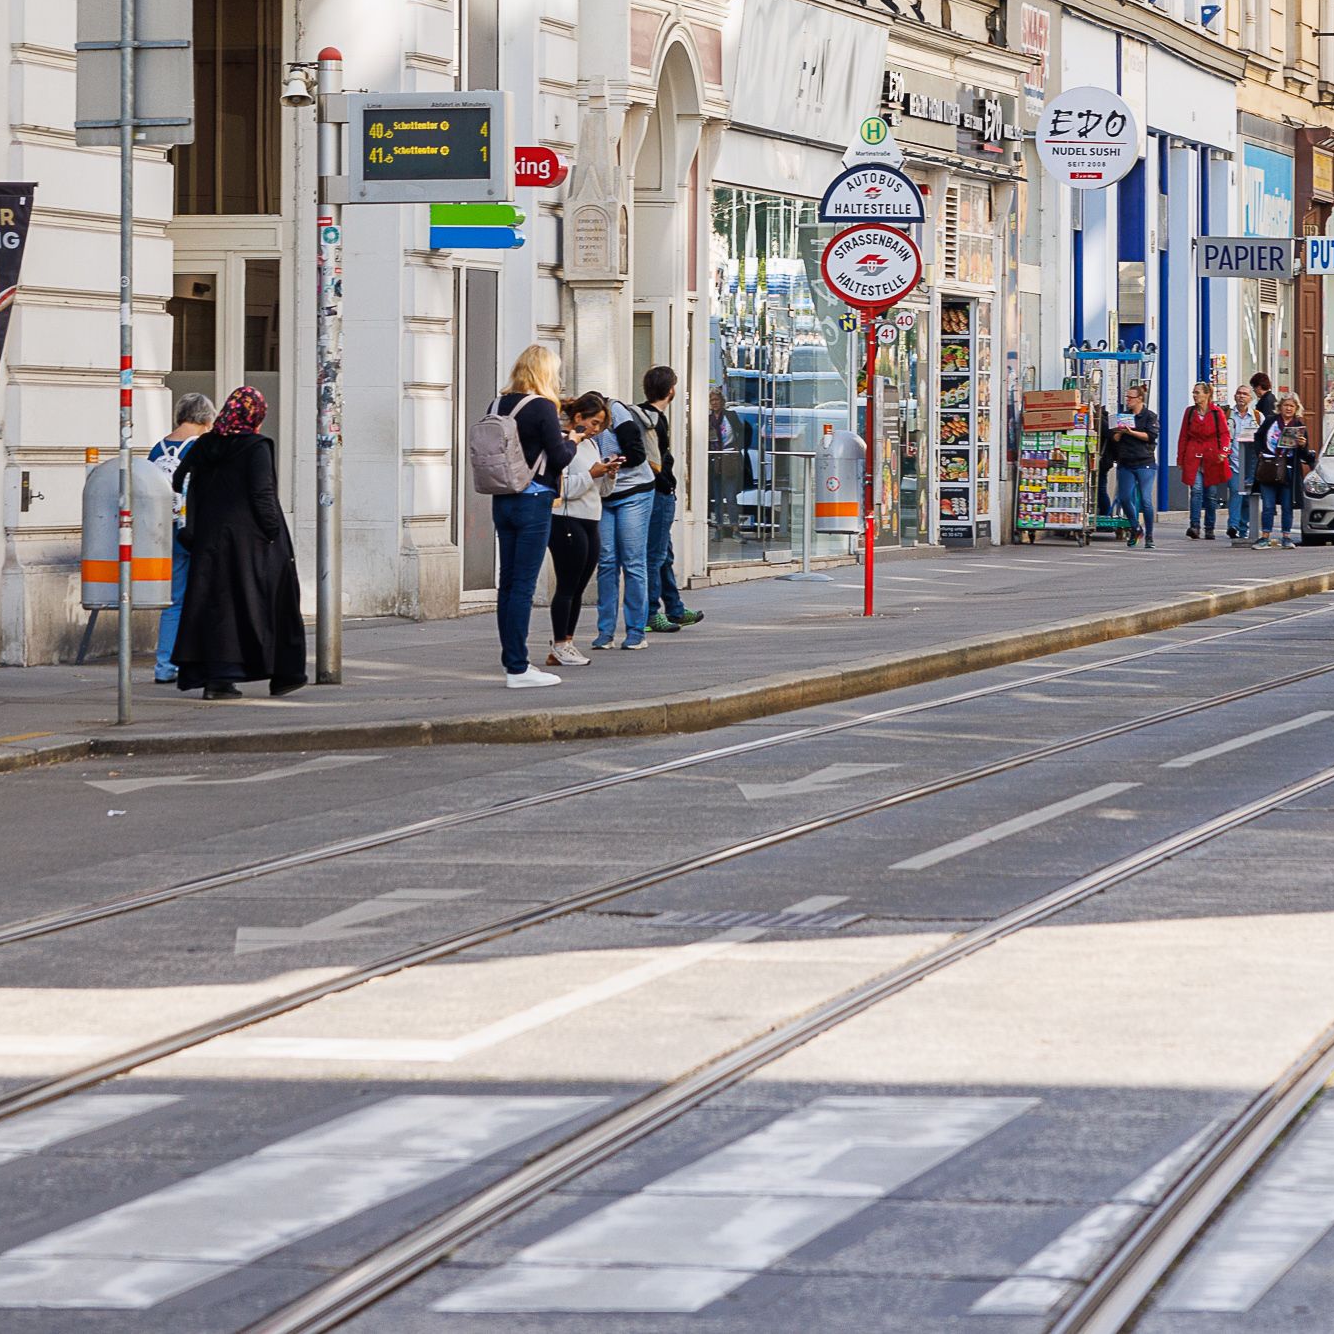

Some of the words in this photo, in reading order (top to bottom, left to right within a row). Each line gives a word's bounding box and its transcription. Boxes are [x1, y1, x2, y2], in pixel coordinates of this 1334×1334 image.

[368, 123, 384, 139] 40
[393, 120, 439, 131] Schottentor
[480, 121, 488, 137] 4
[867, 123, 881, 140] H
[1049, 109, 1127, 139] EDO
[368, 147, 384, 164] 41
[393, 145, 439, 155] Schottentor
[480, 146, 488, 162] 1
[1052, 147, 1087, 156] NUDEL
[1089, 147, 1121, 157] SUSHI
[846, 172, 903, 193] AUTOBUS
[834, 203, 912, 216] HALTESTELLE
[1304, 225, 1316, 236] 119
[833, 233, 913, 262] STRASSENBAHN
[1205, 244, 1285, 271] PAPIER
[835, 272, 908, 297] HALTESTELLE
[896, 315, 914, 326] 40
[880, 328, 895, 339] 41
